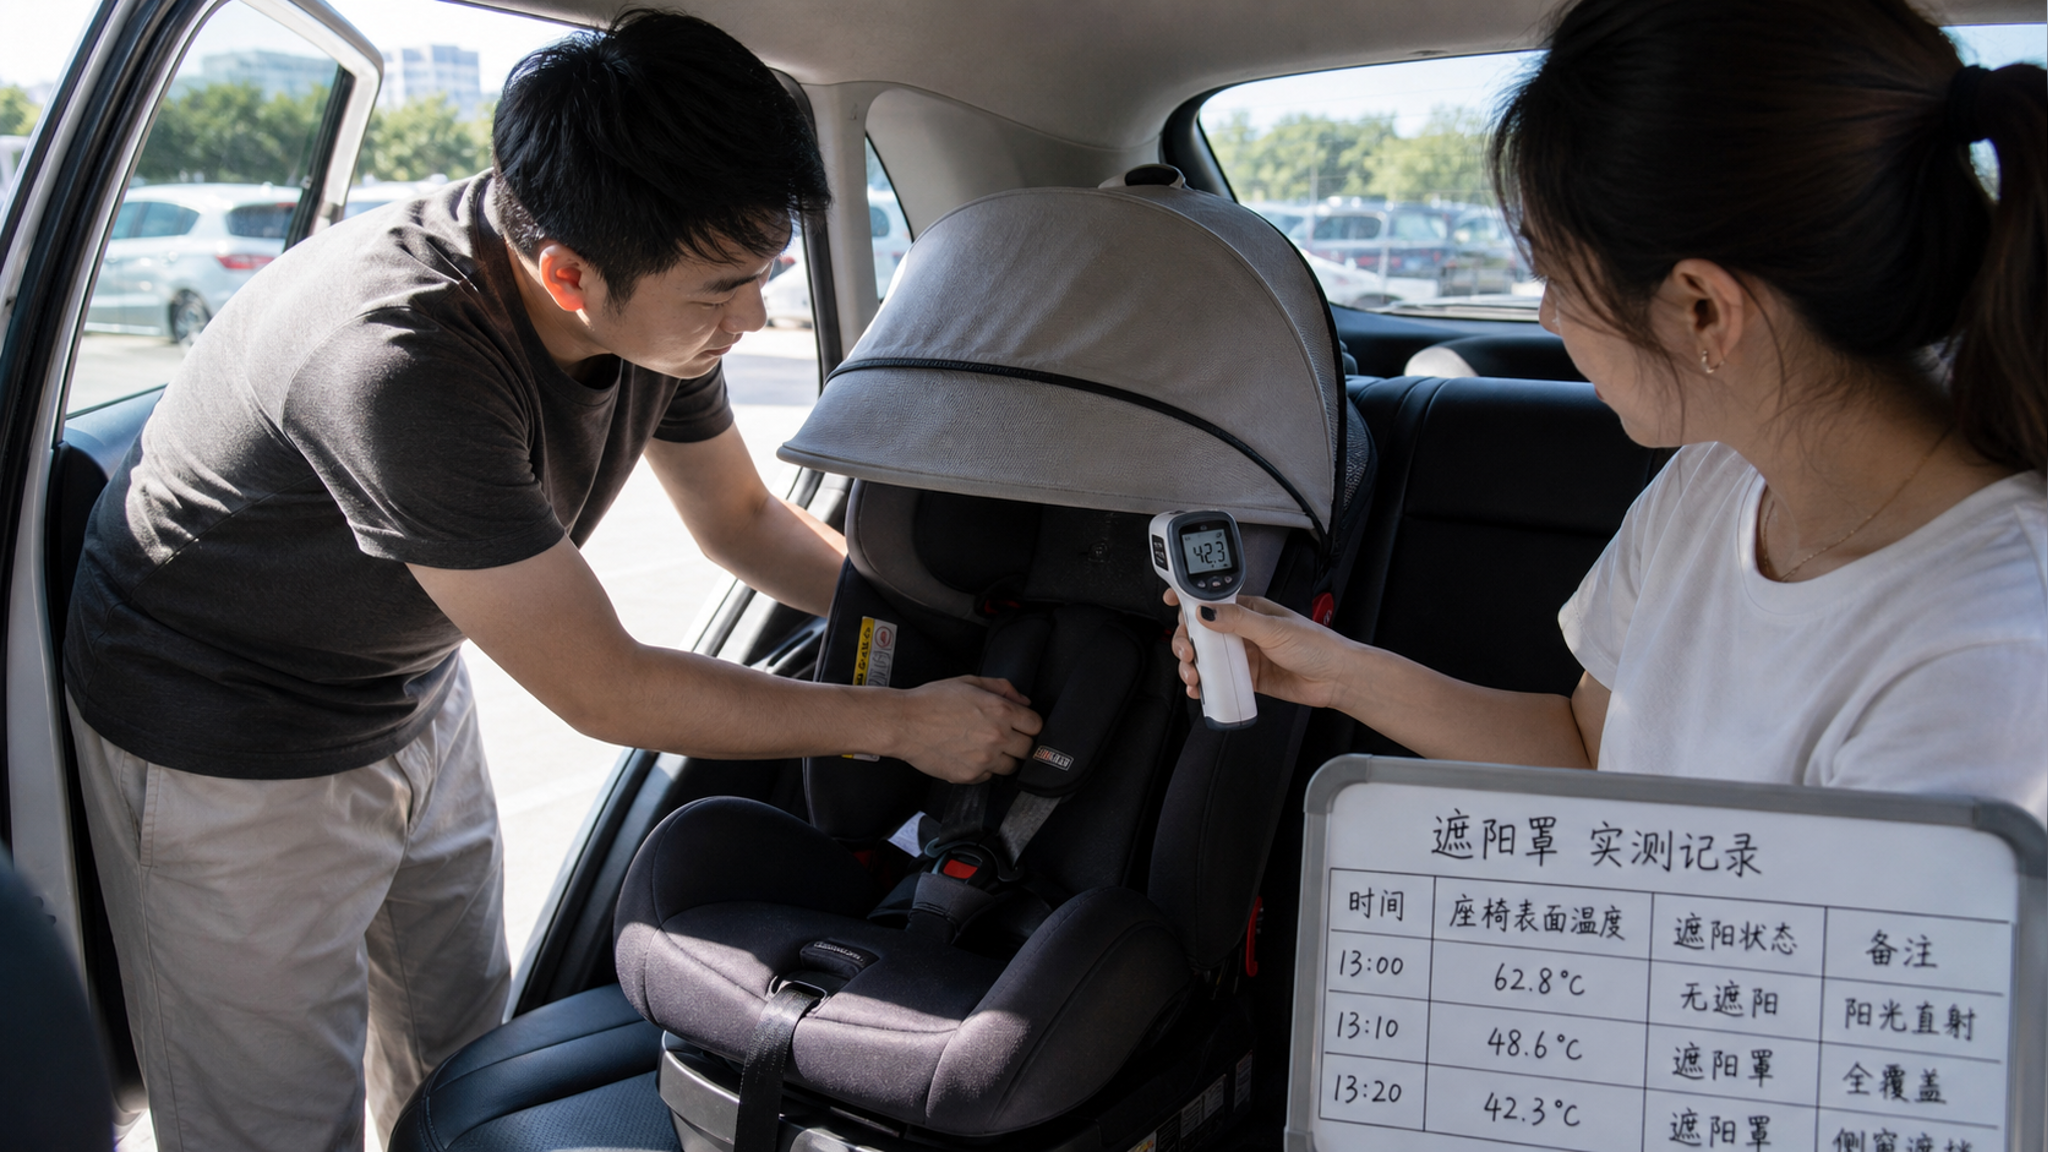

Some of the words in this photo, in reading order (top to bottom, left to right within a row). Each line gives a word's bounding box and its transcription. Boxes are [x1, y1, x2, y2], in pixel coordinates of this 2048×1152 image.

[1193, 541, 1225, 564] 42.3
[1431, 808, 1557, 867] 遮阳罩
[1590, 821, 1762, 878] 实测记录
[1349, 887, 1404, 921] 时间
[1450, 894, 1625, 941] 座椅表面温度
[1673, 912, 1797, 956] 遮阳状态
[1866, 929, 1937, 968] 备注
[1340, 950, 1403, 977] 13:00
[1494, 963, 1585, 996] 62.8°C
[1681, 980, 1778, 1018] 无遮阳
[1337, 1012, 1398, 1039] 13:10
[1845, 998, 1976, 1041] 阳光直射
[1487, 1027, 1582, 1060] 48.6°C
[1672, 1042, 1773, 1087] 遮阳罩
[1843, 1061, 1946, 1104] 全覆盖
[1334, 1075, 1402, 1104] 13:20
[1484, 1092, 1580, 1127] 42.3°C
[1669, 1107, 1771, 1152] 遮阳罩
